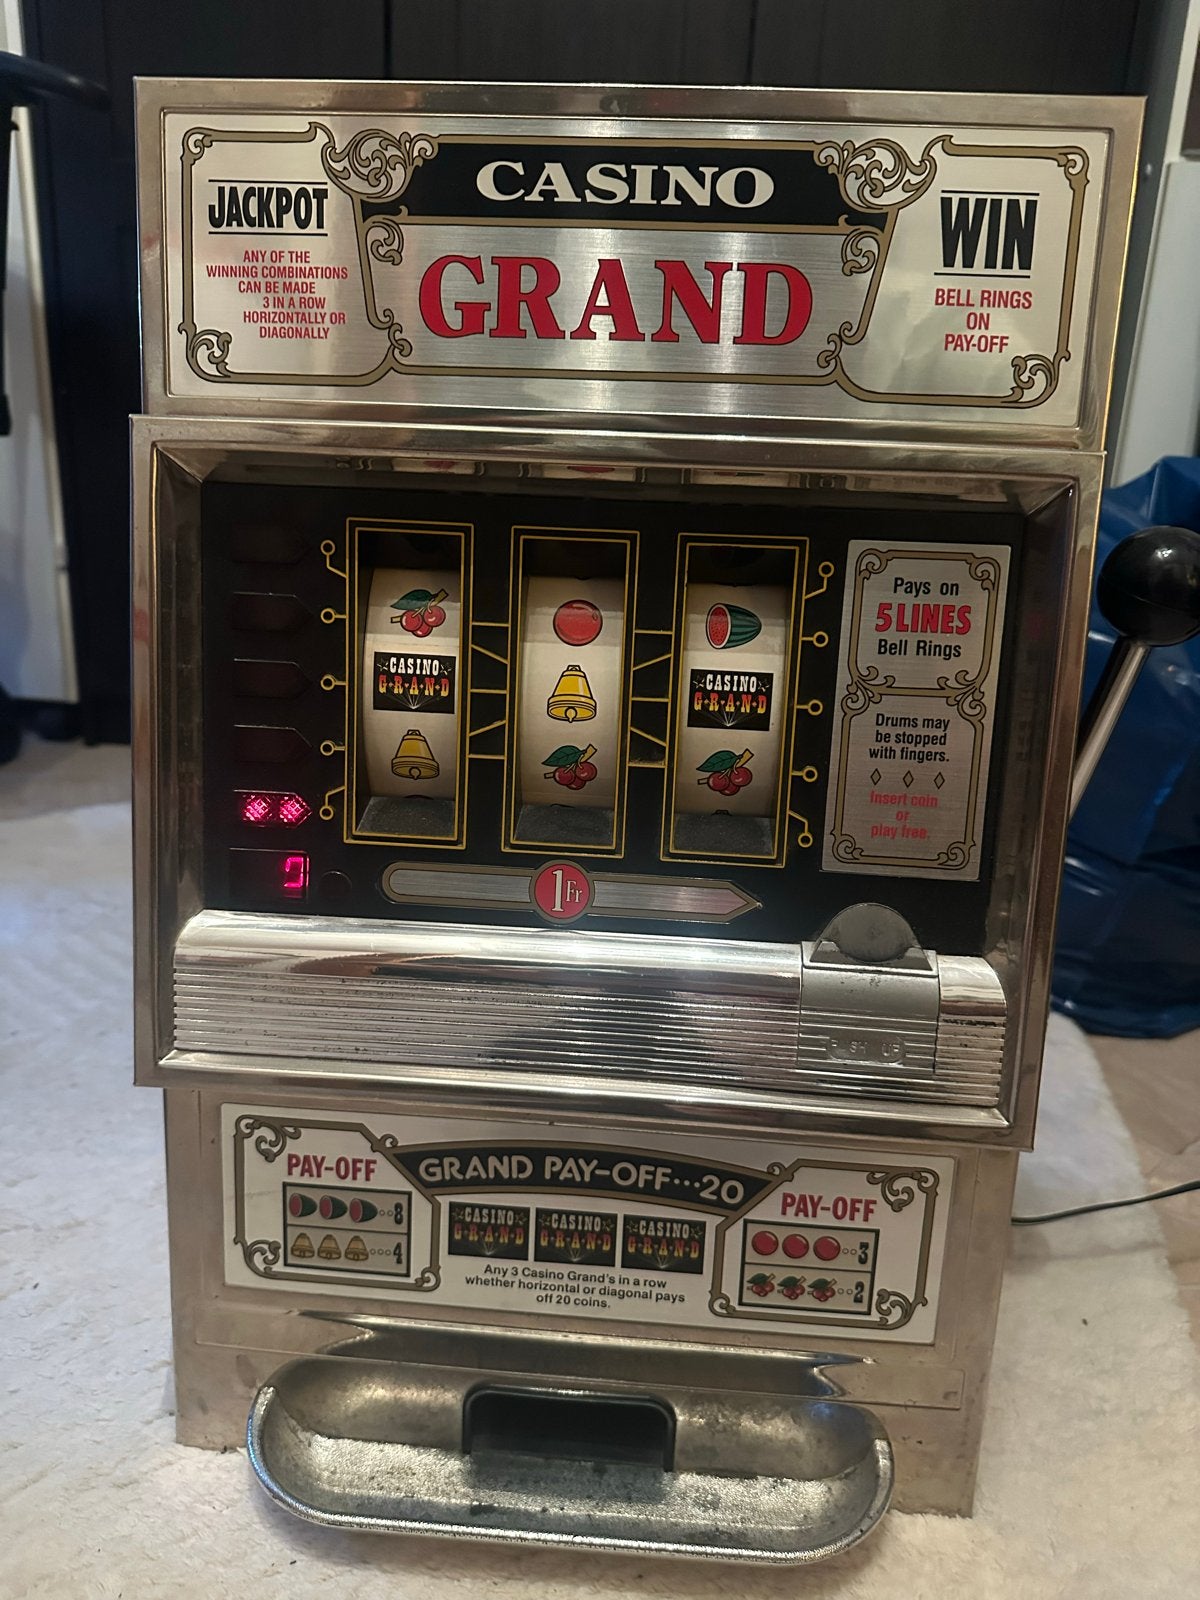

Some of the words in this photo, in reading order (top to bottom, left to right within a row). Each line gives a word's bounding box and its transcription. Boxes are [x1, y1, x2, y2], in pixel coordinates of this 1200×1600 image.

[476, 160, 775, 209] CASINO
[208, 185, 329, 230] JACKPOT
[940, 196, 1038, 270] WIN
[243, 250, 267, 263] ANY
[270, 250, 285, 263] OF
[288, 251, 310, 264] THE
[206, 265, 258, 278] WINNING
[261, 265, 348, 280] COMBINATIONS
[238, 280, 261, 293] CAN
[265, 281, 279, 294] BE
[282, 281, 316, 294] MADE
[263, 296, 270, 309] 3
[273, 297, 284, 309] IN
[288, 297, 296, 309] A
[299, 297, 326, 309] ROW
[418, 254, 813, 346] GRAND
[935, 288, 975, 307] BELL
[980, 289, 1033, 309] RINGS
[243, 311, 327, 325] HORIZONTALLY
[330, 312, 346, 325] OR
[966, 312, 990, 331] ON
[259, 326, 330, 339] DIAGONALLY
[944, 333, 1009, 353] PAY-OFF
[893, 577, 931, 598] Pays
[940, 582, 960, 596] on
[877, 638, 908, 656] Bell
[916, 640, 962, 660] Rings
[389, 656, 440, 676] CASINO
[705, 673, 757, 693] CASINO
[875, 713, 918, 728] Drums
[922, 718, 950, 732] may
[875, 730, 891, 743] be
[894, 731, 947, 747] stopped
[869, 746, 896, 759] with
[900, 747, 950, 763] fingers.
[870, 790, 907, 805] Insert
[911, 795, 938, 807] coin
[896, 811, 910, 821] or
[871, 824, 898, 839] play
[287, 1153, 378, 1182] PAY-OFF
[418, 1154, 533, 1182] GRAND
[394, 1202, 403, 1225] 8
[464, 1206, 515, 1225] CASINO
[781, 1192, 878, 1223] PAY-OFF
[551, 1213, 601, 1232] CASINO
[639, 1219, 690, 1239] CASINO
[393, 1242, 403, 1265] 4
[858, 1242, 869, 1265] 3
[484, 1264, 508, 1278] Any
[511, 1266, 519, 1277] 3
[522, 1267, 564, 1281] Casino
[567, 1270, 616, 1285] Grand's
[618, 1274, 630, 1286] in
[632, 1277, 640, 1286] a
[643, 1278, 667, 1289] row
[465, 1275, 515, 1289] whether
[518, 1278, 580, 1294] horizontal
[583, 1285, 596, 1295] or
[598, 1285, 653, 1300] diagonal
[655, 1291, 686, 1304] pays
[853, 1281, 865, 1304] 2
[536, 1293, 554, 1303] off
[556, 1294, 571, 1305] 20
[573, 1296, 611, 1309] coins.
